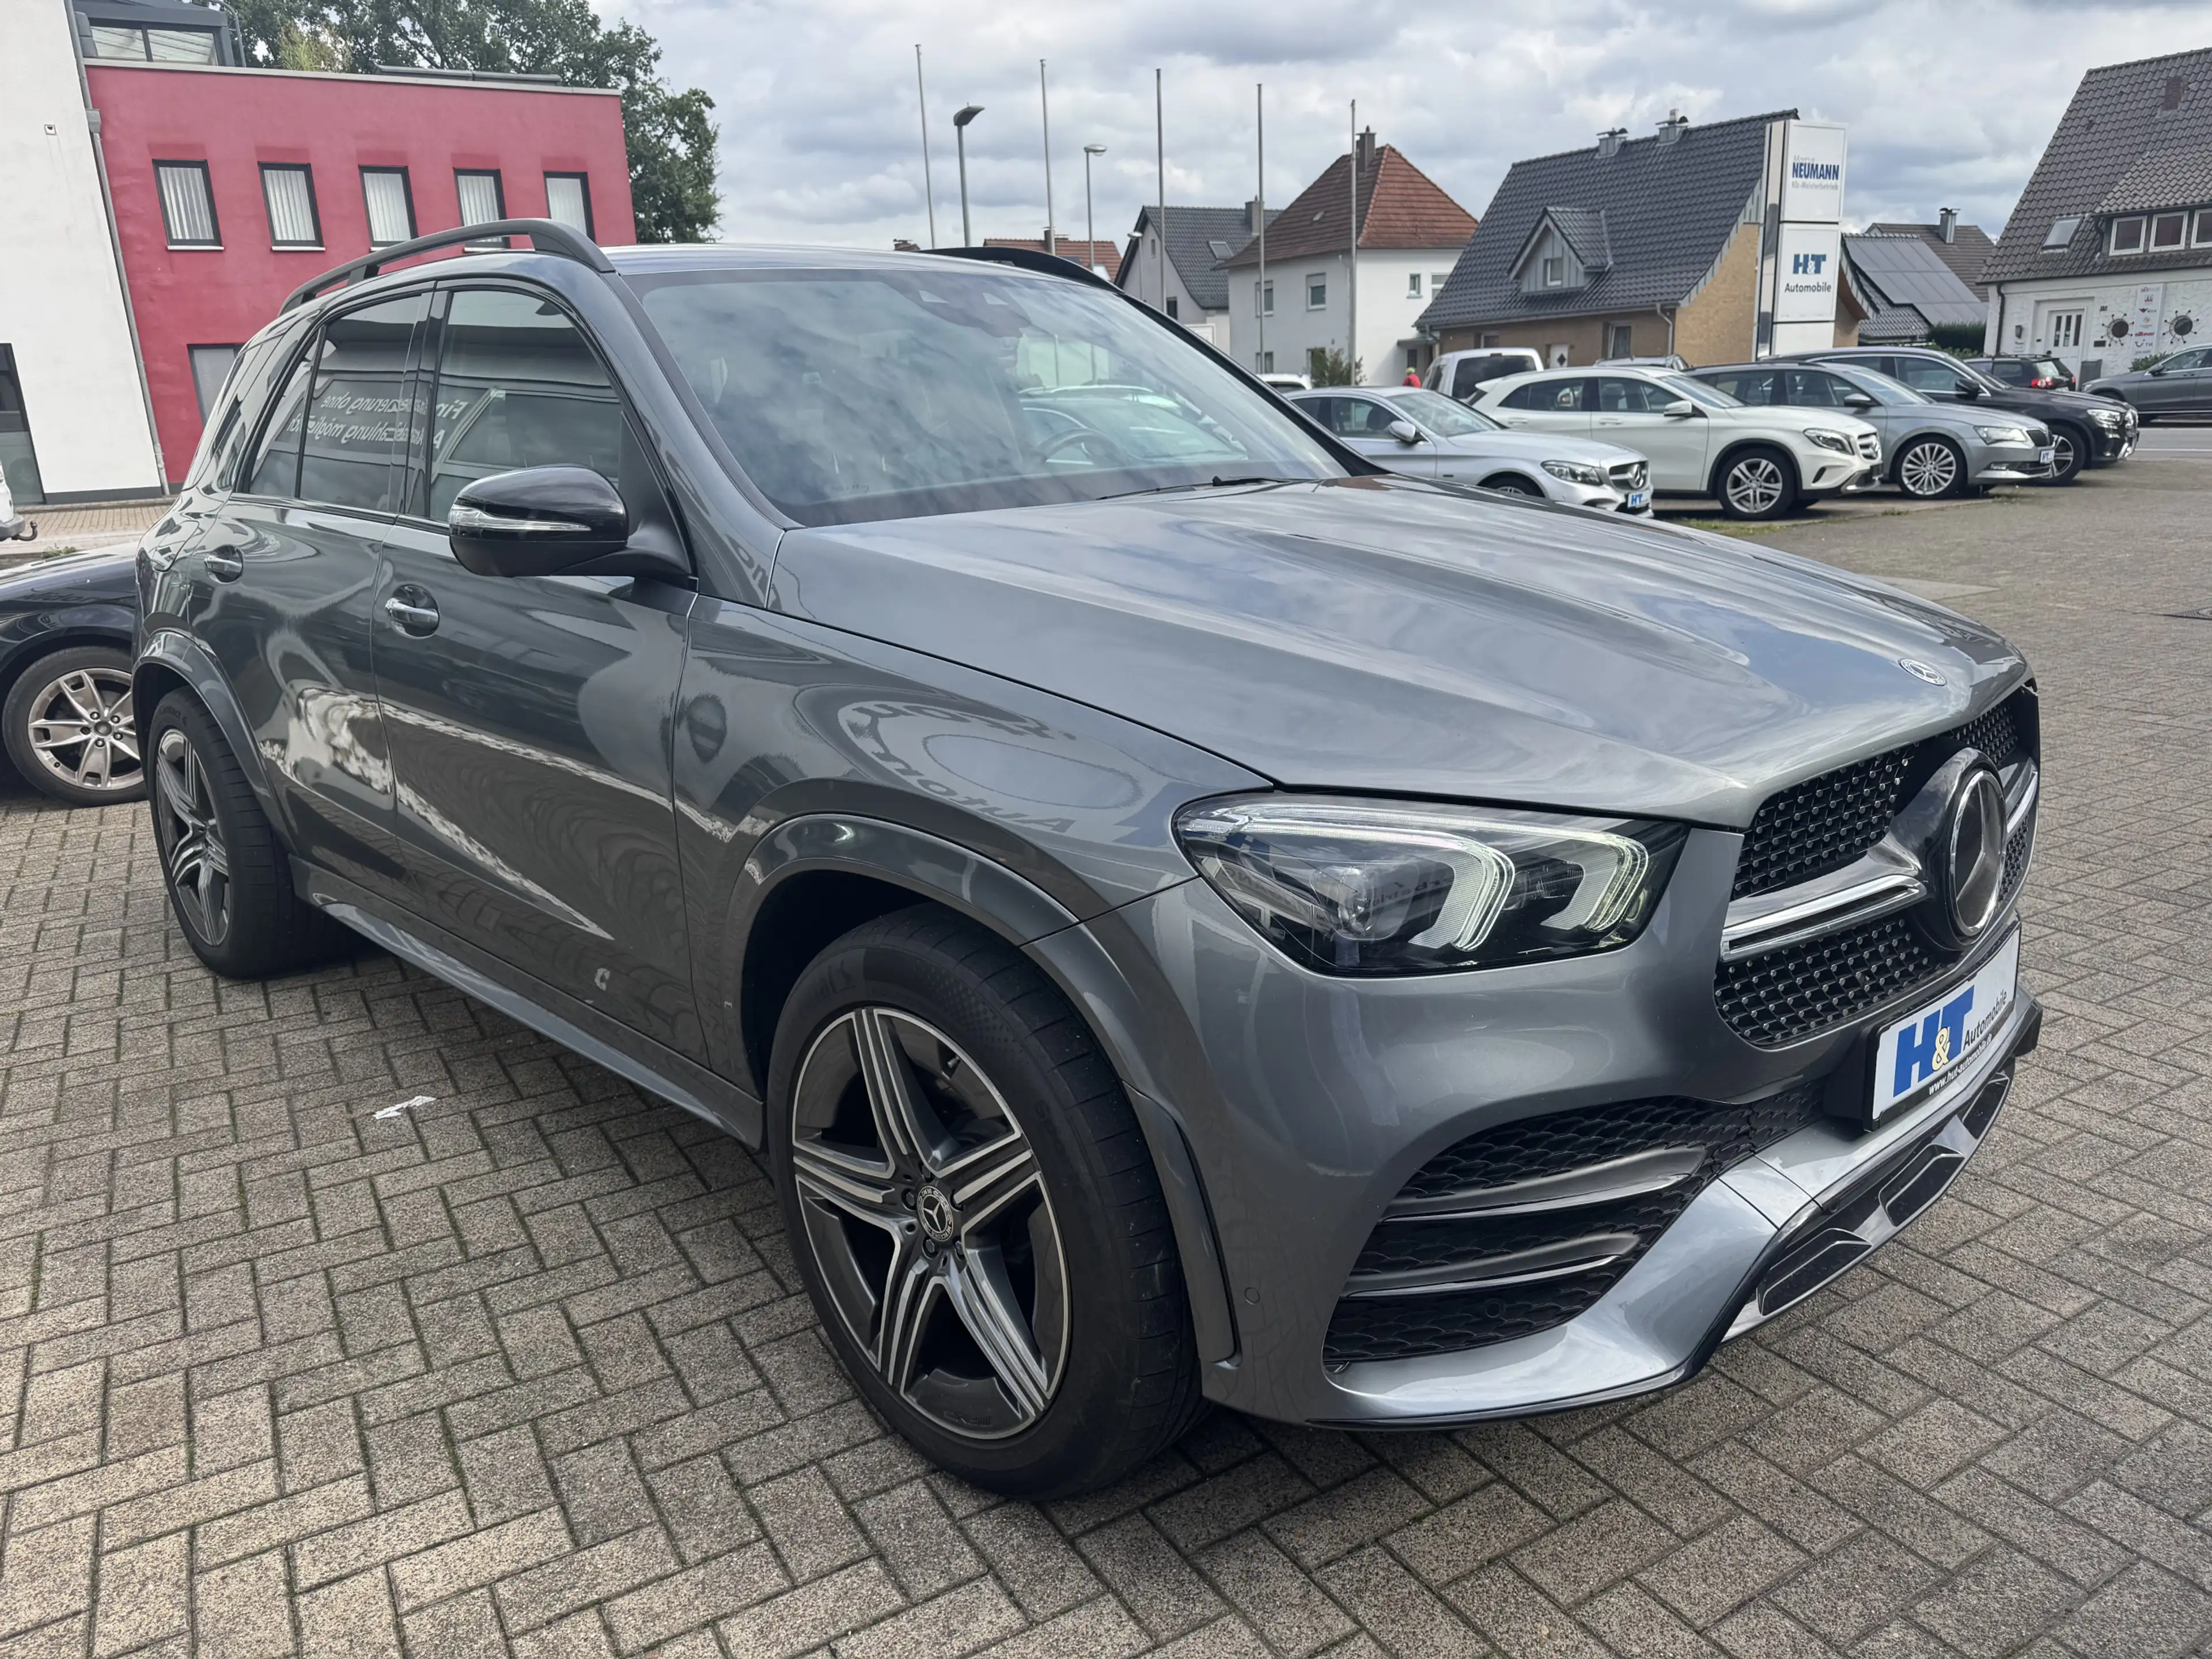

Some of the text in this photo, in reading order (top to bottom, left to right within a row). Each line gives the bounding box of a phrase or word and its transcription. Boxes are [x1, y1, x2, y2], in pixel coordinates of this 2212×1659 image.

[1792, 162, 1839, 180] NEUMANN
[1793, 253, 1826, 275] H&T
[1785, 282, 1832, 293] Automobile
[1963, 989, 2007, 1051] Automobile
[1893, 984, 1975, 1097] H&T
